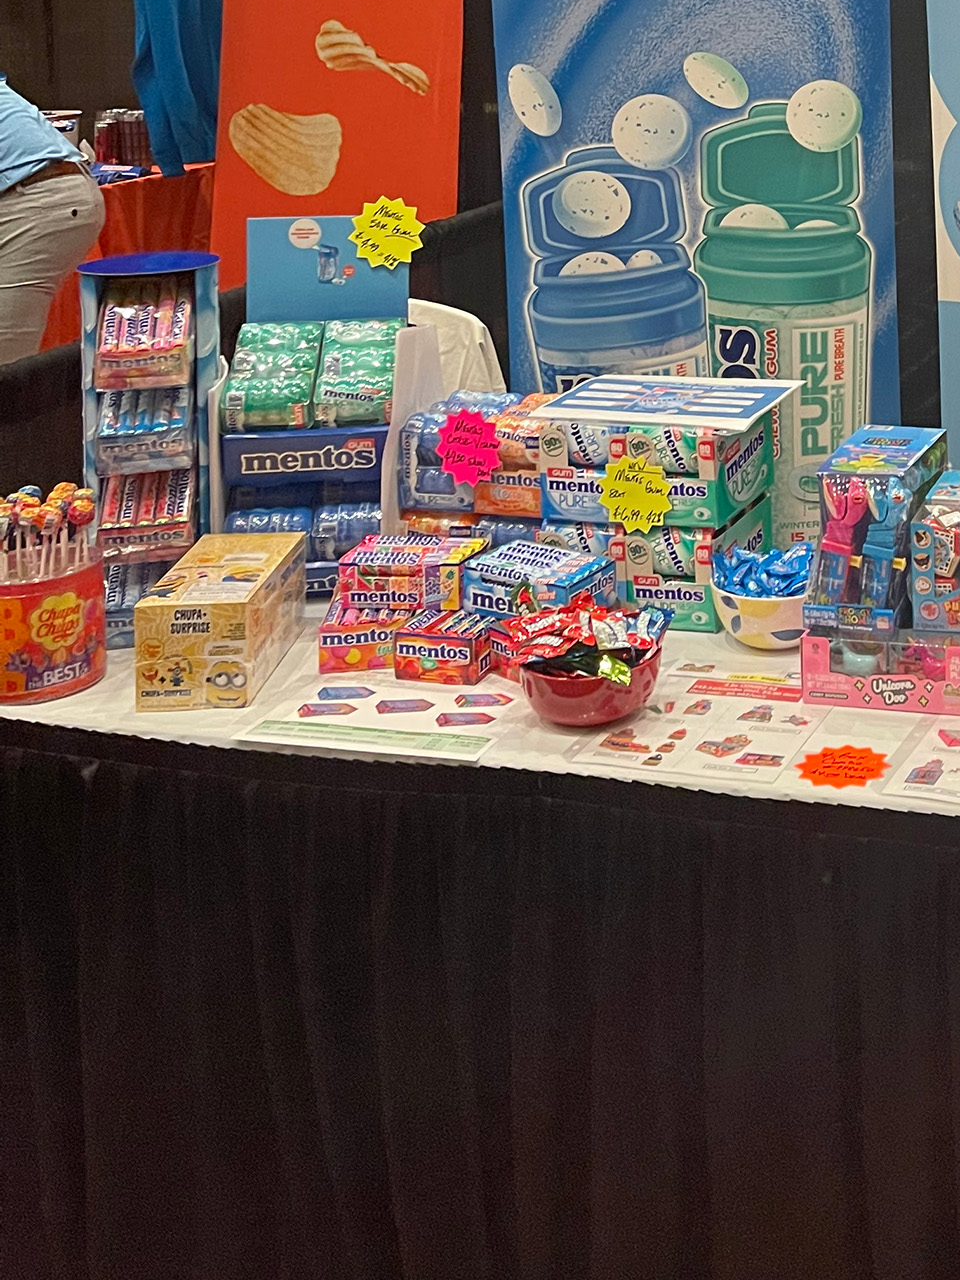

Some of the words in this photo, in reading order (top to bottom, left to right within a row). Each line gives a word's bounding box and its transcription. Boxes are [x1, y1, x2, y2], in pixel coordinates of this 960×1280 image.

[763, 328, 778, 376] GUM
[834, 327, 845, 360] BREATH
[834, 359, 845, 381] PURE
[322, 388, 375, 404] mentos
[800, 330, 829, 457] PURE
[102, 437, 184, 456] mentos
[495, 430, 527, 443] entos
[570, 422, 595, 466] mento
[663, 426, 688, 472] mento
[726, 429, 765, 482] mentos
[242, 447, 375, 473] mentos
[548, 479, 604, 494] mento
[668, 483, 708, 498] ntos
[121, 478, 137, 520] mentos
[103, 528, 186, 547] mentos
[791, 532, 804, 543] 15
[661, 528, 686, 575] mento
[475, 562, 532, 582] mentos
[106, 564, 122, 604] mento
[635, 586, 705, 602] mentos
[350, 590, 419, 604] mentos
[472, 591, 516, 613] men
[170, 621, 212, 635] SURPRISE
[397, 643, 469, 661] mentos
[43, 662, 82, 686] BEST
[872, 677, 915, 694] Unicorn
